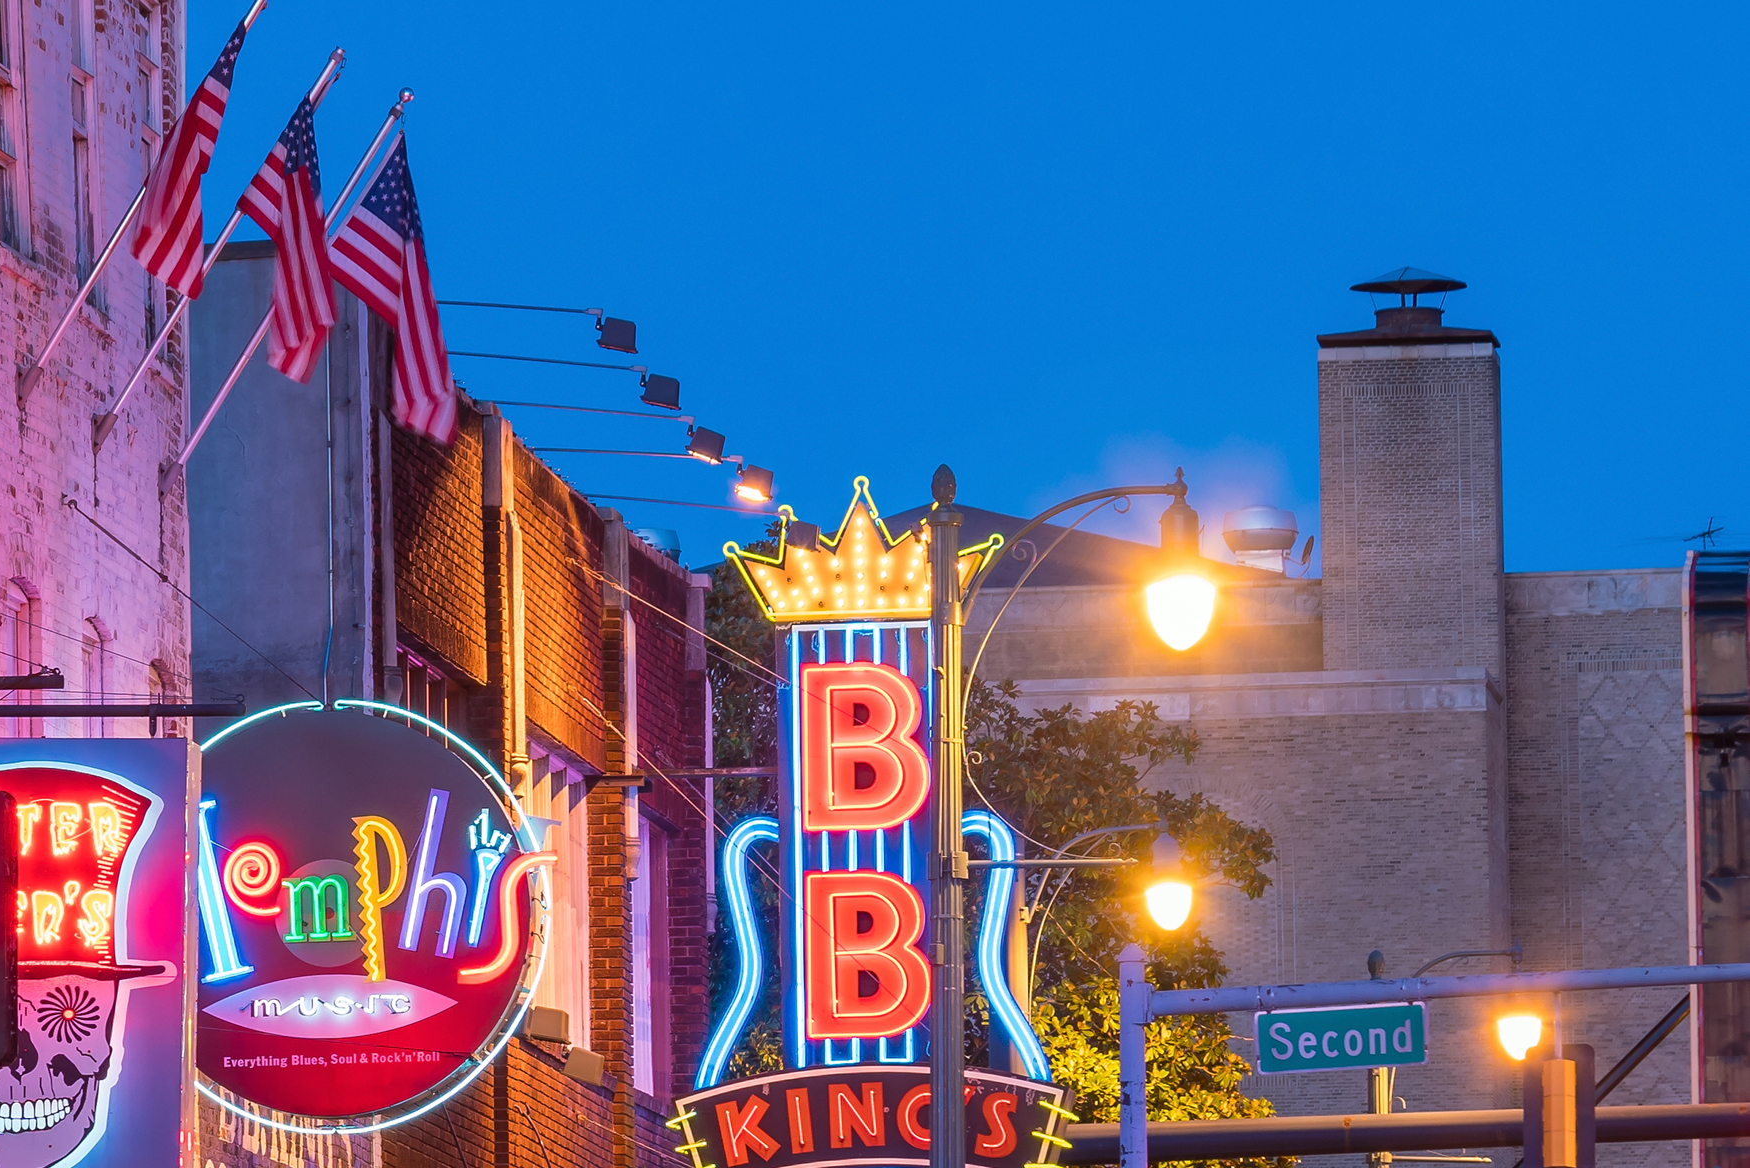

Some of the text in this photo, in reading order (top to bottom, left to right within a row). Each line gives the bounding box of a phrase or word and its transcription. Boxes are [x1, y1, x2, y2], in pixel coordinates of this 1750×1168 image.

[17, 801, 120, 858] TER
[223, 1055, 288, 1069] Everything
[291, 1053, 328, 1068] Blues,
[330, 1053, 357, 1066] Soul
[359, 1053, 368, 1065] &
[1269, 1018, 1413, 1062] Second
